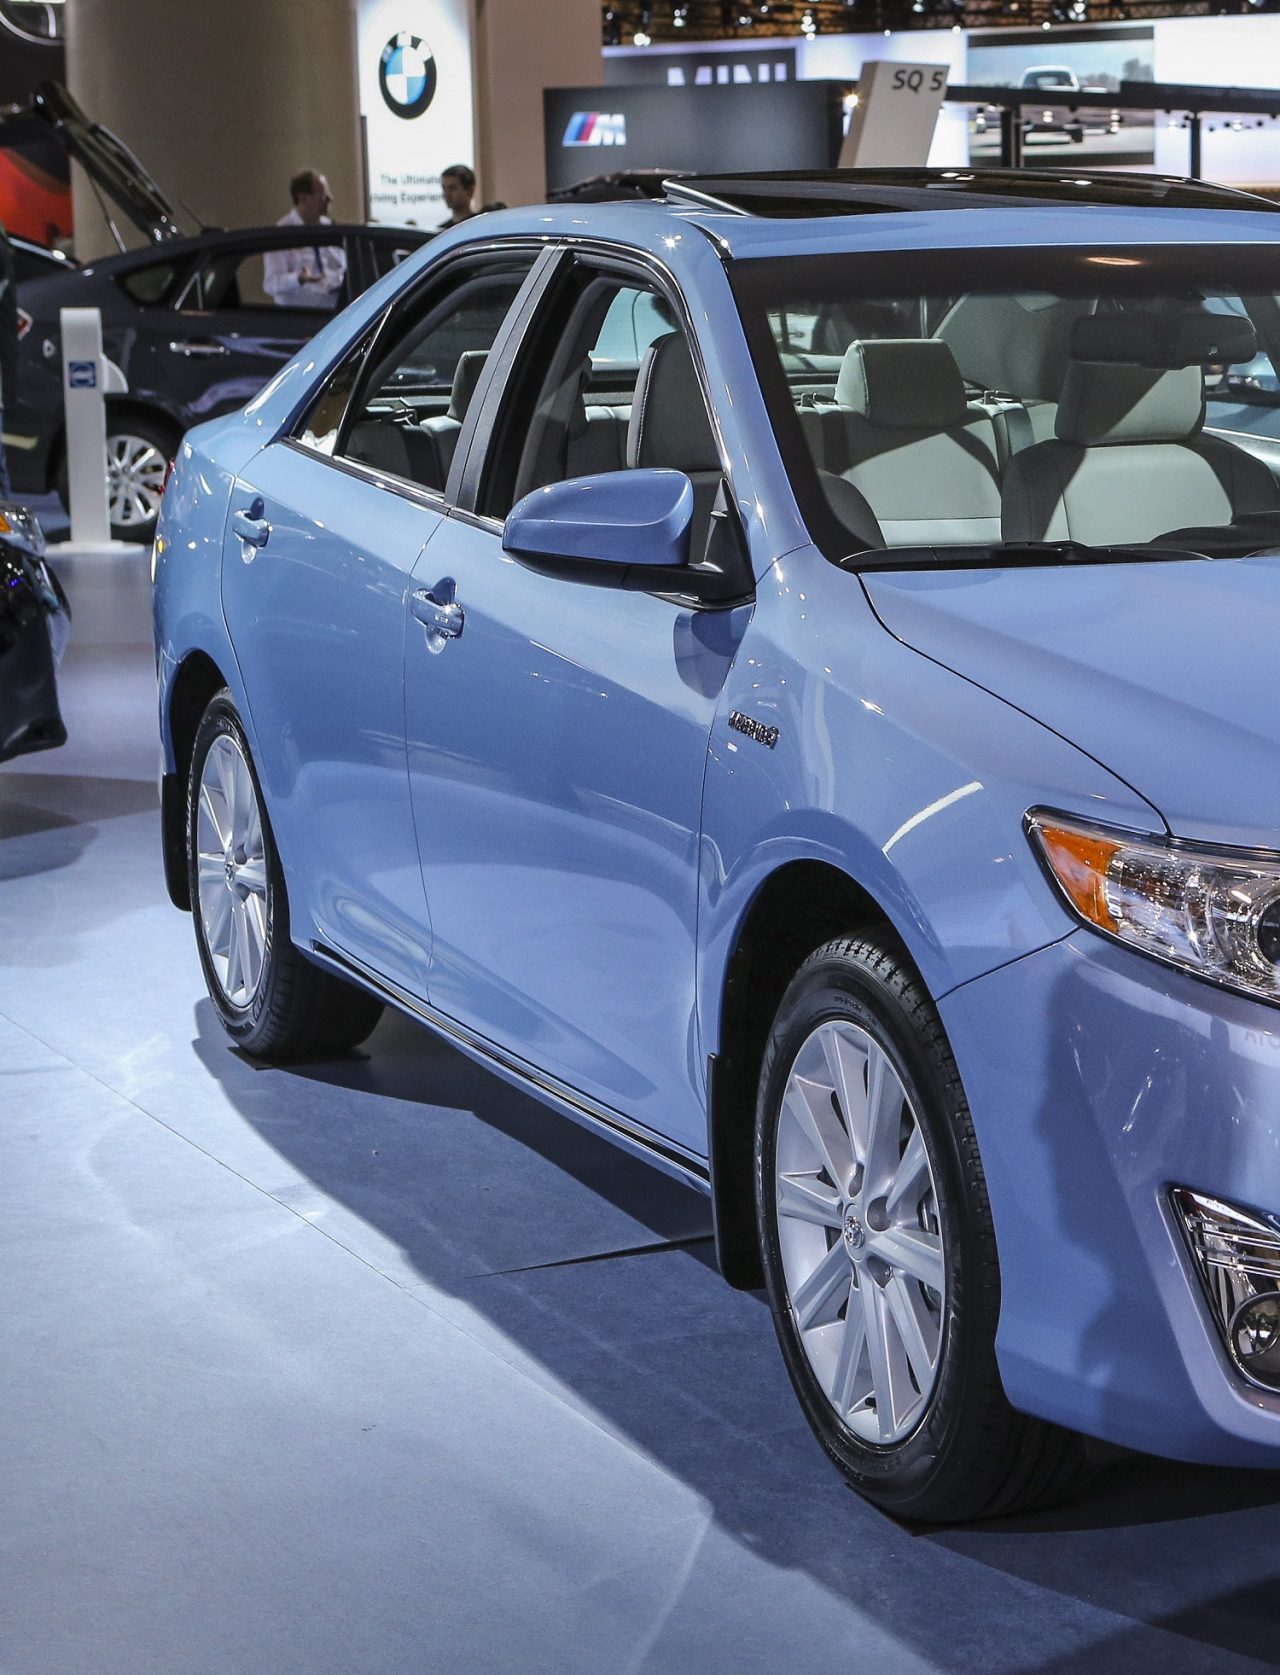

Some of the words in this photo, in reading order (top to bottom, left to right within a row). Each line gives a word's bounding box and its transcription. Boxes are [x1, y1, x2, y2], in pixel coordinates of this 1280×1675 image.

[891, 69, 923, 94] SQ
[930, 70, 945, 91] 5
[381, 174, 397, 185] The
